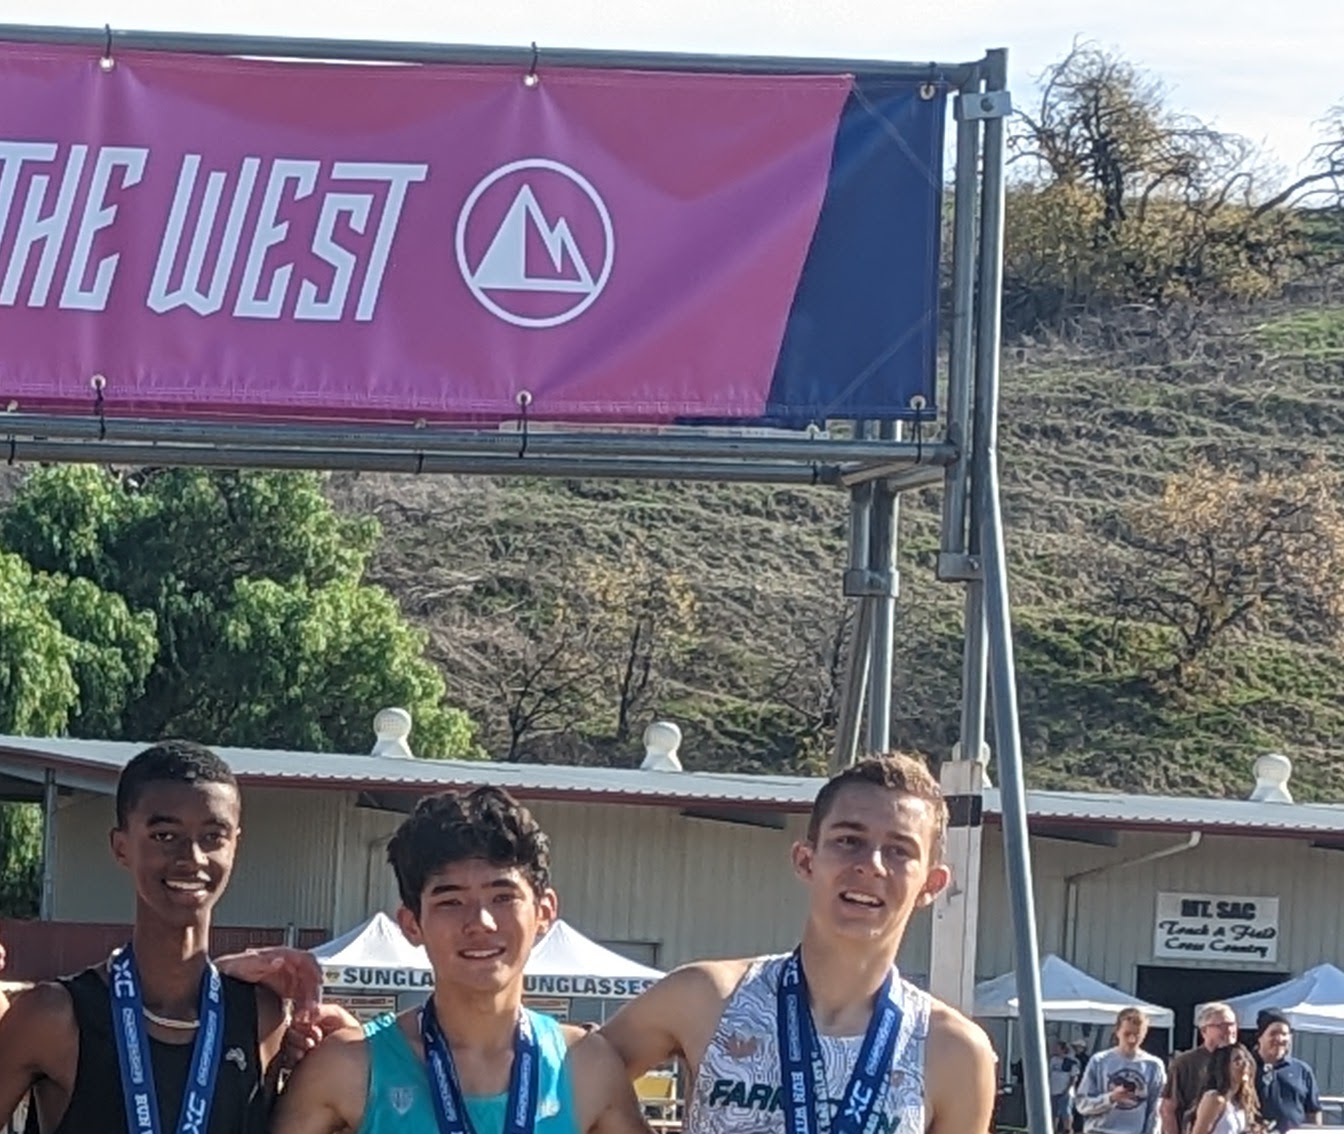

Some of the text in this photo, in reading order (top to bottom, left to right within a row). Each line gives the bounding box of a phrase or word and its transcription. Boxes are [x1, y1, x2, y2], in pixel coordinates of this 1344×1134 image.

[146, 154, 428, 321] WEST
[1216, 901, 1256, 920] SAC
[1159, 920, 1209, 935] Track
[1231, 924, 1276, 940] Field
[1165, 937, 1268, 958] Cross Country
[343, 966, 433, 987] SUNGLA
[790, 1071, 806, 1103] RUN
[134, 1094, 151, 1127] RUN
